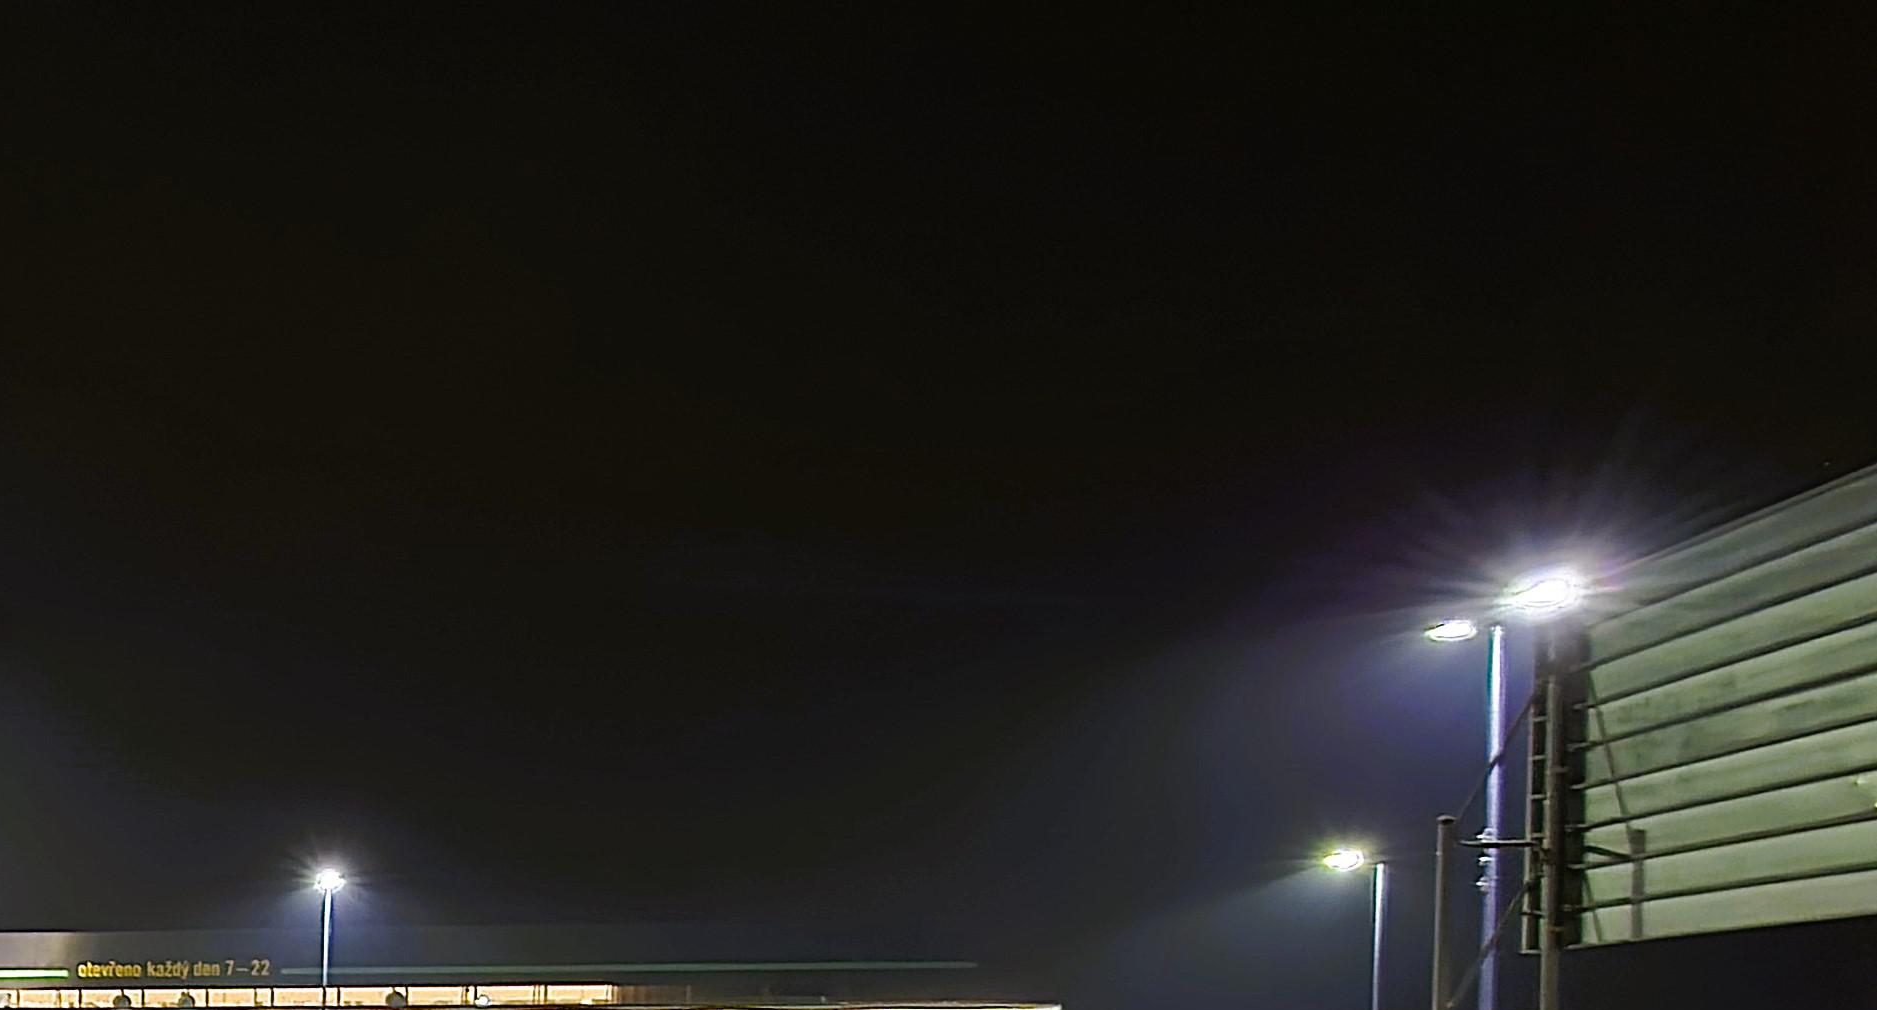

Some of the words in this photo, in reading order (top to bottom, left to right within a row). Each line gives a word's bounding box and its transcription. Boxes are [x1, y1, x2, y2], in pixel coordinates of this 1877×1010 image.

[77, 960, 142, 978] otevřeno
[146, 960, 189, 980] každý
[192, 960, 221, 978] den
